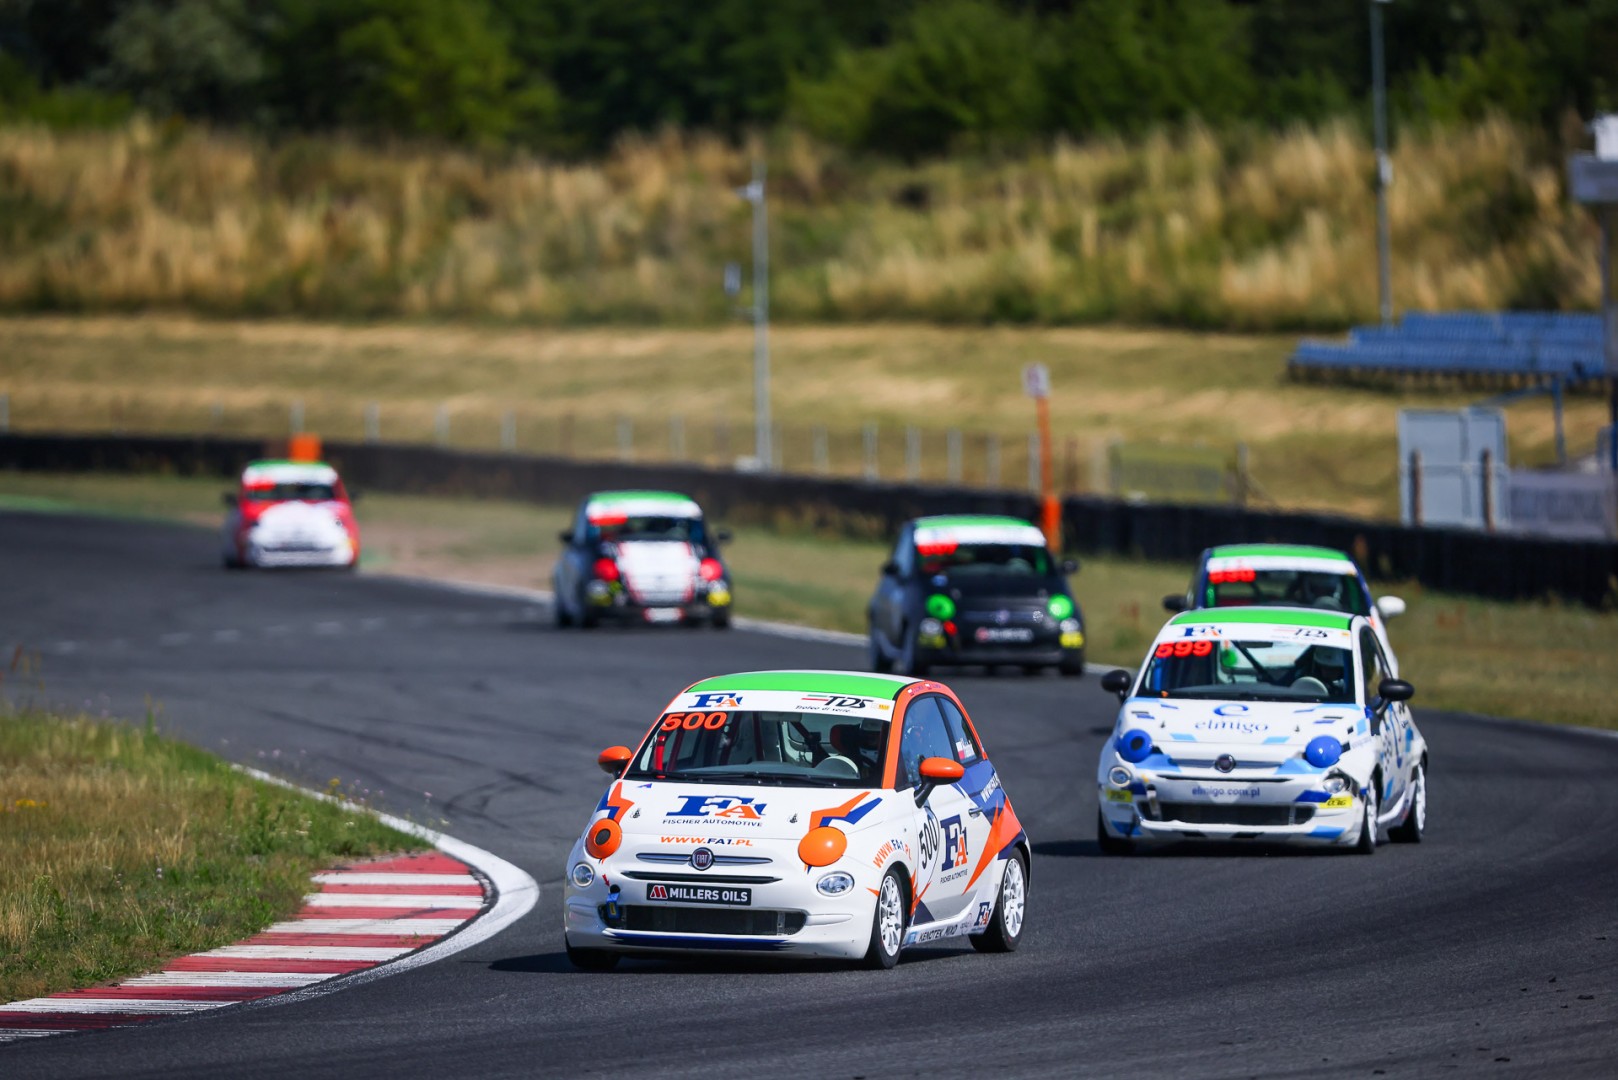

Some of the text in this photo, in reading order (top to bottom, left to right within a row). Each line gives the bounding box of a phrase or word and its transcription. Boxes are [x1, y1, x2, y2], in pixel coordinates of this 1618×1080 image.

[1155, 640, 1213, 658] 599
[688, 693, 743, 708] FA1
[824, 695, 874, 709] TDS
[660, 711, 728, 731] 500
[1195, 719, 1269, 733] elmigo
[1192, 786, 1260, 798] elmigo.com.pl
[665, 795, 767, 819] FA1
[702, 818, 763, 827] AUTOMOTIVE
[660, 836, 753, 847] WWW.FA1.PL
[918, 815, 938, 870] 500
[940, 814, 969, 872] FA1
[696, 854, 708, 864] FIAT
[669, 887, 748, 902] MILLERS OILS
